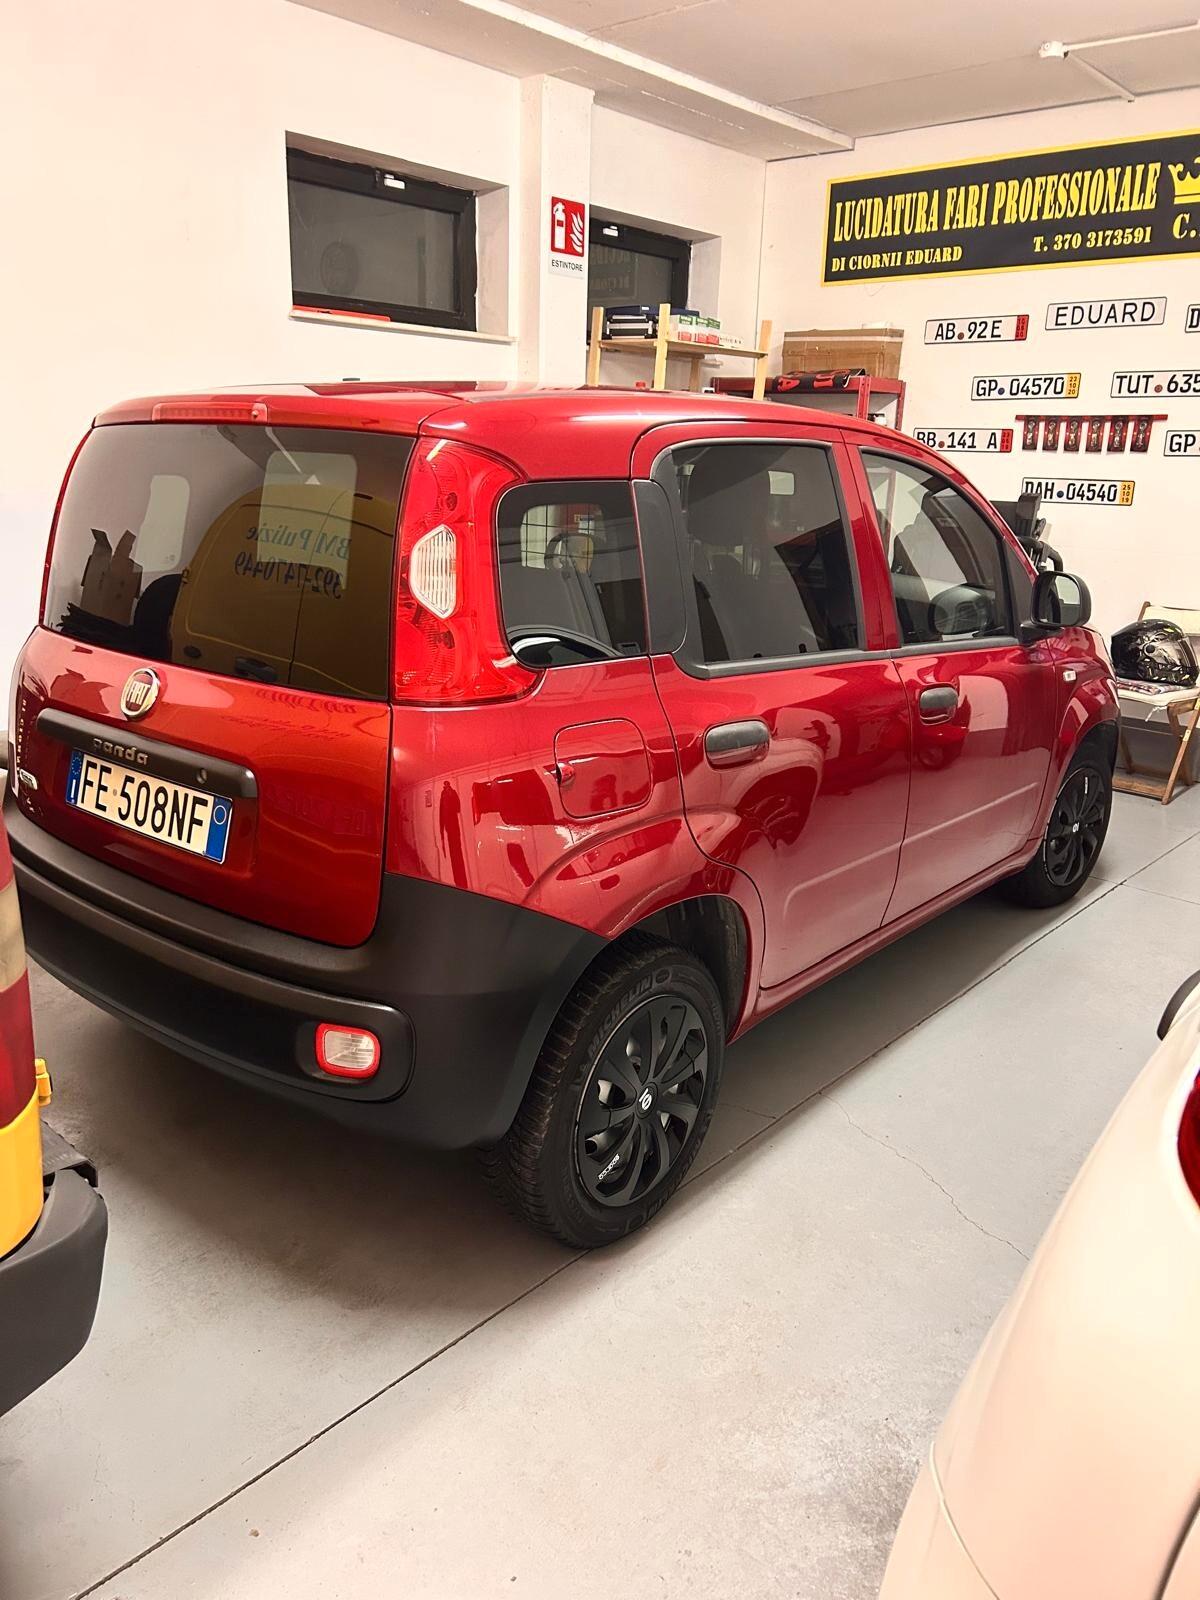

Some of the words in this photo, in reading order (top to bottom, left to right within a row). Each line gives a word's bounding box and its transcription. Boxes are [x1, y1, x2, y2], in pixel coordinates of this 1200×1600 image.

[833, 189, 939, 242] LUCIDATURA
[943, 183, 990, 230] FARI
[991, 162, 1161, 224] PROFESSIONALE
[1033, 236, 1048, 252] T.
[1053, 233, 1082, 251] 370
[1086, 226, 1152, 248] 3173591
[551, 259, 583, 272] ESTINTORE
[832, 257, 847, 272] DI
[849, 251, 902, 270] CIORNII
[905, 246, 962, 265] EDUARD
[1054, 301, 1156, 326] EDUARD
[1009, 376, 1065, 396] 04570
[946, 432, 977, 449] 141
[987, 431, 998, 449] A
[1066, 482, 1118, 502] 04540
[80, 760, 112, 812] FE
[117, 774, 208, 844] 508NF
